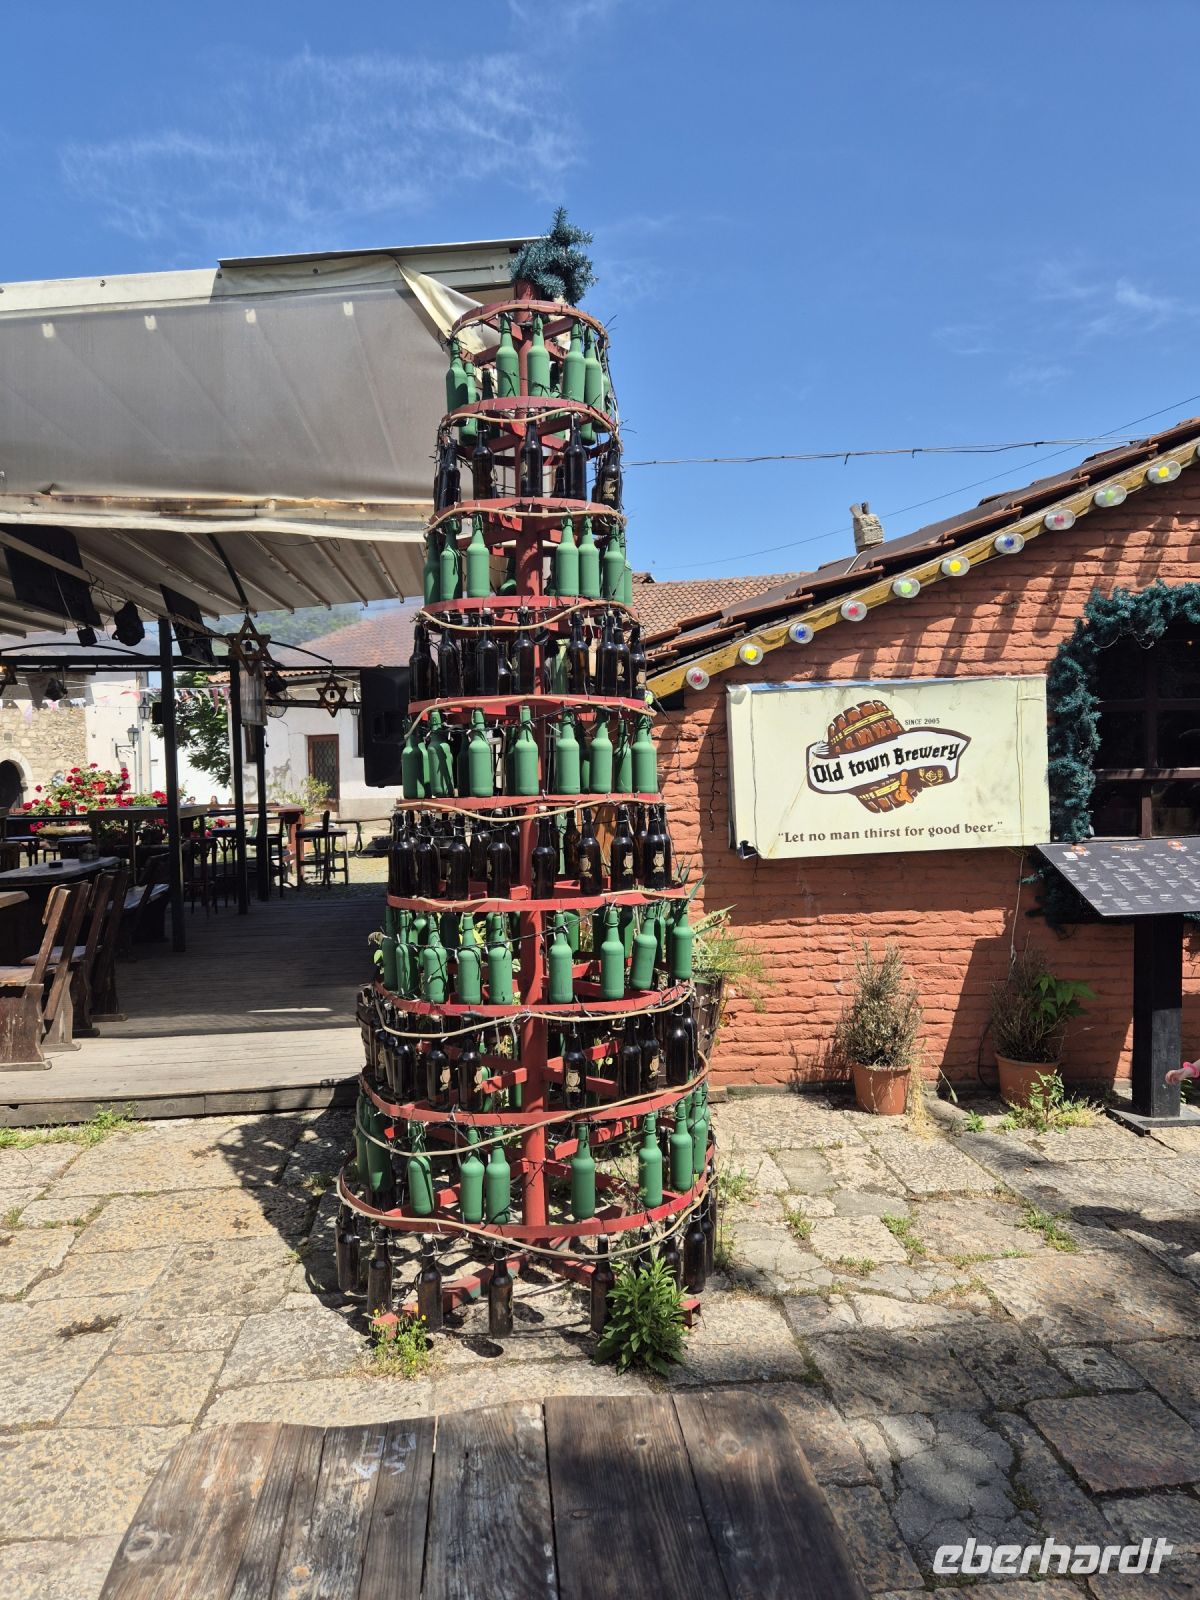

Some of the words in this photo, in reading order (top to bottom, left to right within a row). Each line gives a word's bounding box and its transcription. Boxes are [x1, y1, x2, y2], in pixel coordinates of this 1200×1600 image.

[904, 718, 922, 726] SINCE
[812, 760, 844, 783] Old
[848, 752, 891, 777] town
[893, 743, 960, 765] Brewery
[809, 832, 826, 841] no
[830, 831, 859, 840] man
[864, 827, 901, 839] thirst
[905, 826, 924, 836] for
[928, 824, 960, 837] good
